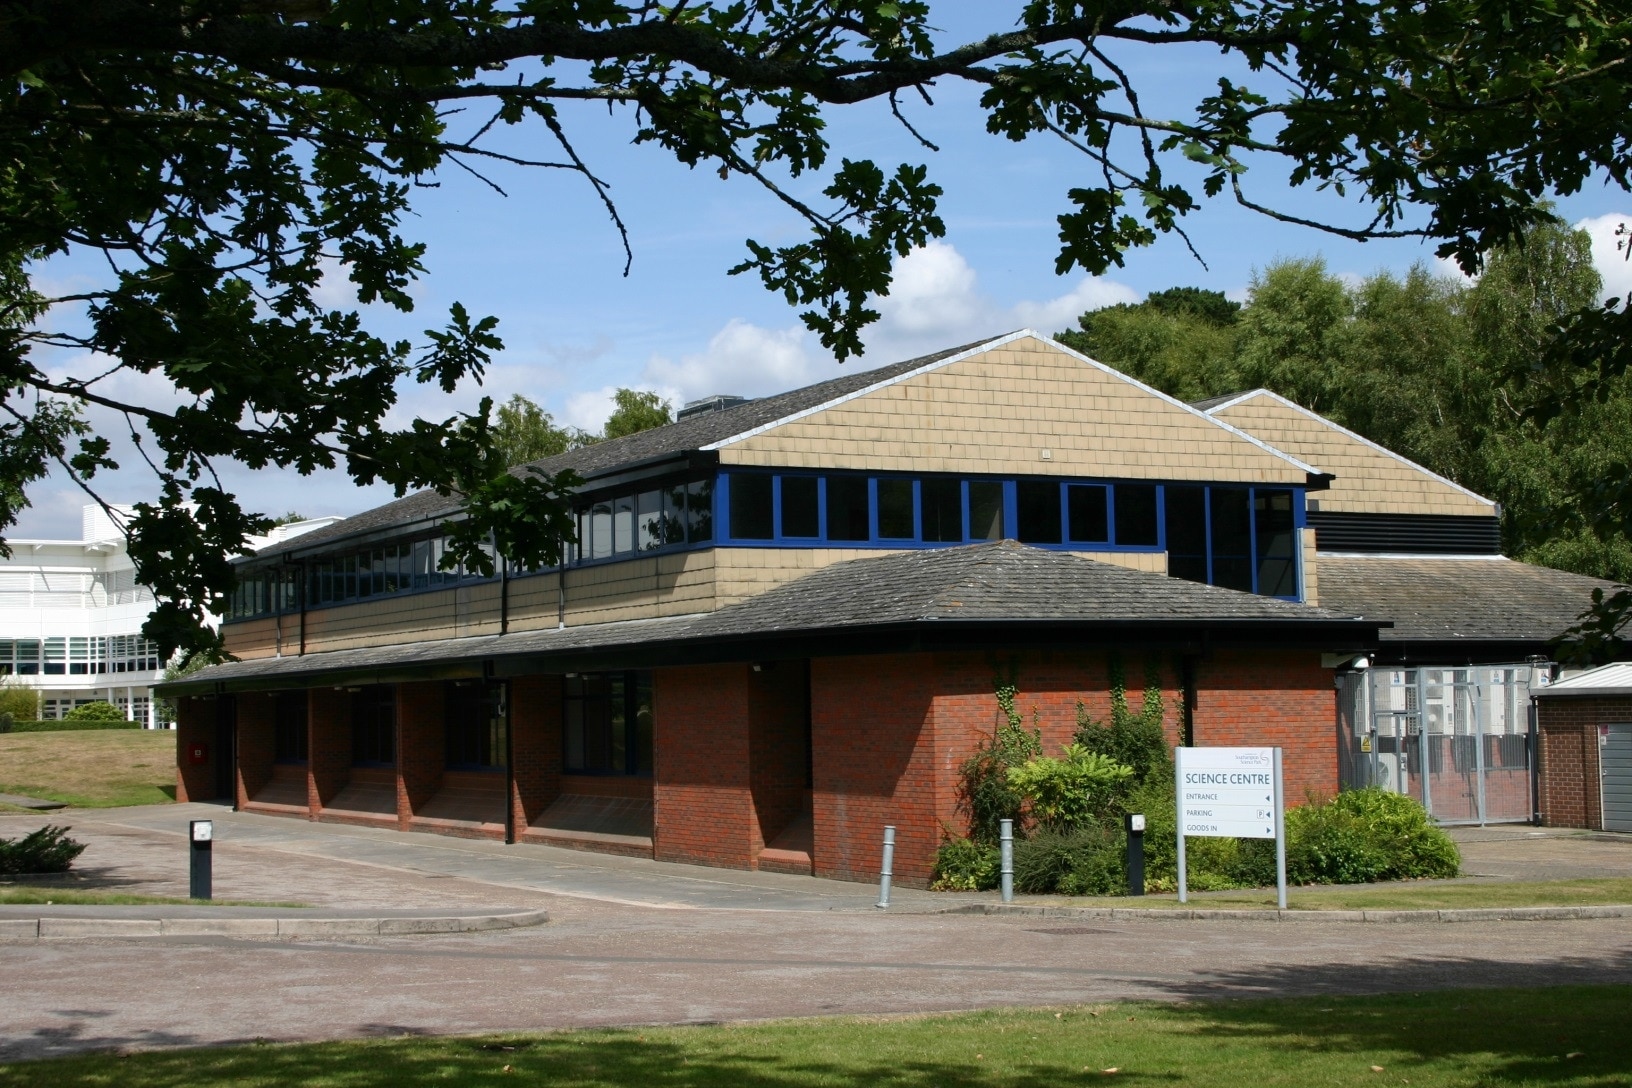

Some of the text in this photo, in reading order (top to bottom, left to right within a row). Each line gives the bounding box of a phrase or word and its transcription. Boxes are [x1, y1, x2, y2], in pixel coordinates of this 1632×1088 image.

[1186, 773, 1270, 785] SCIENCE CENTRE
[1186, 793, 1218, 801] ENTRANCE
[1187, 824, 1209, 832] GOODS
